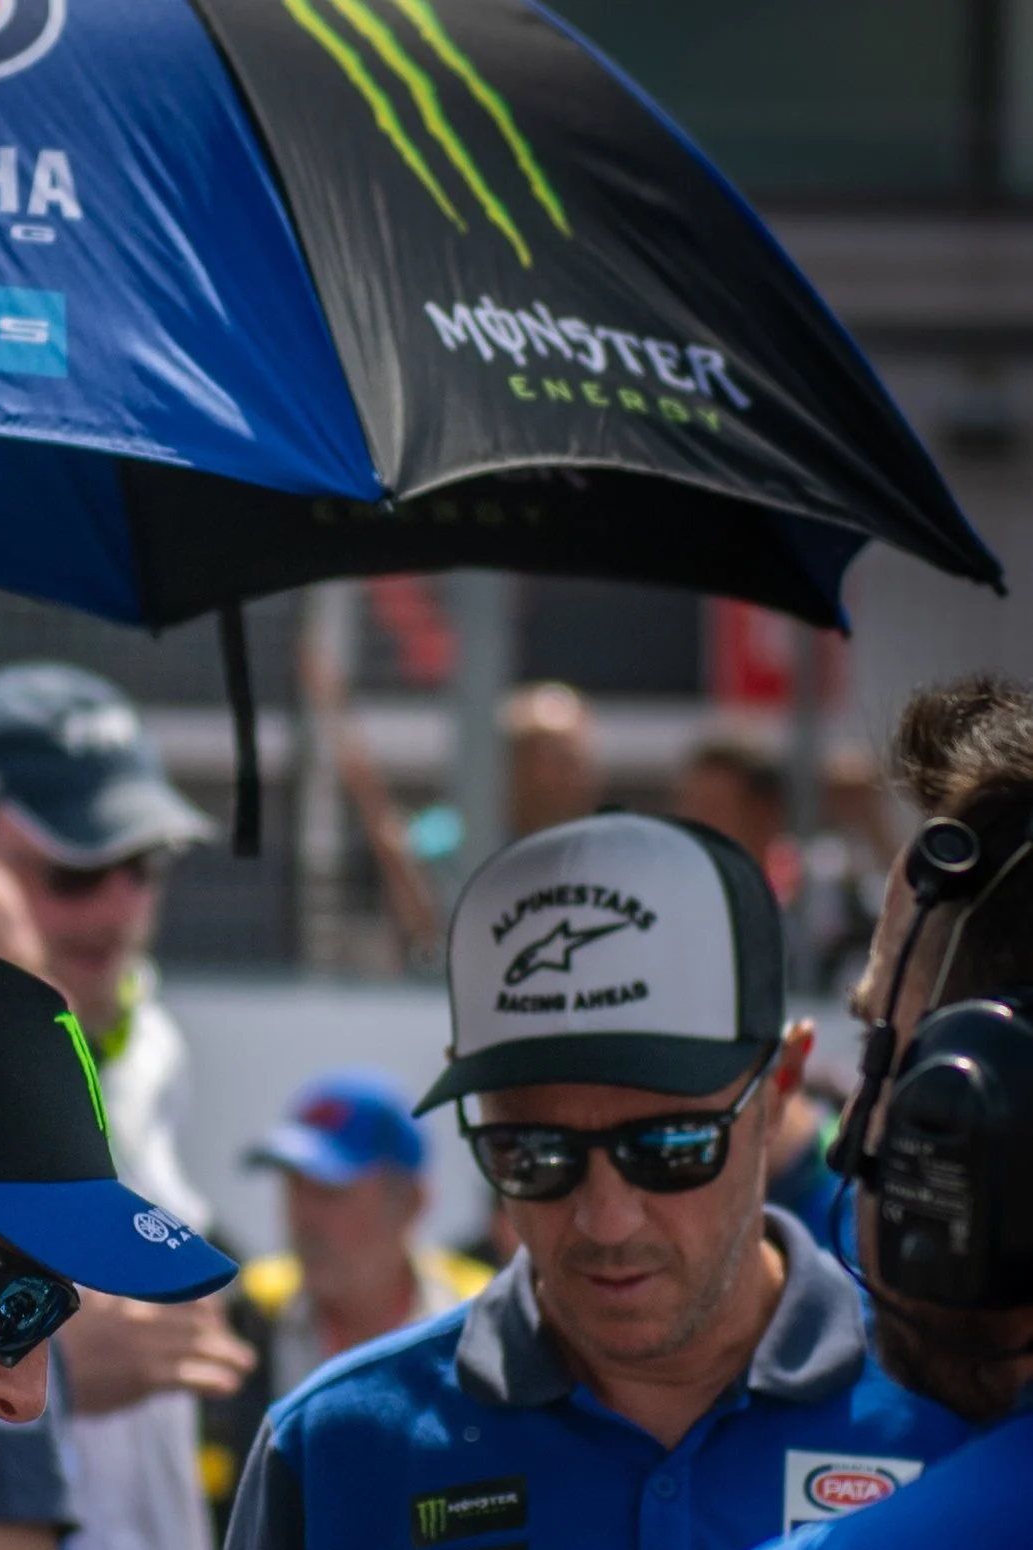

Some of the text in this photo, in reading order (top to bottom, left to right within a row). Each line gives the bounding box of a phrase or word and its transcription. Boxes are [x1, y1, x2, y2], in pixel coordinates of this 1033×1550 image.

[423, 295, 752, 410] MONSTER
[507, 375, 719, 432] ENERGY
[492, 884, 657, 946] ALPINESTARS
[496, 978, 650, 1014] RACING AHEAD
[824, 1478, 884, 1500] PATA
